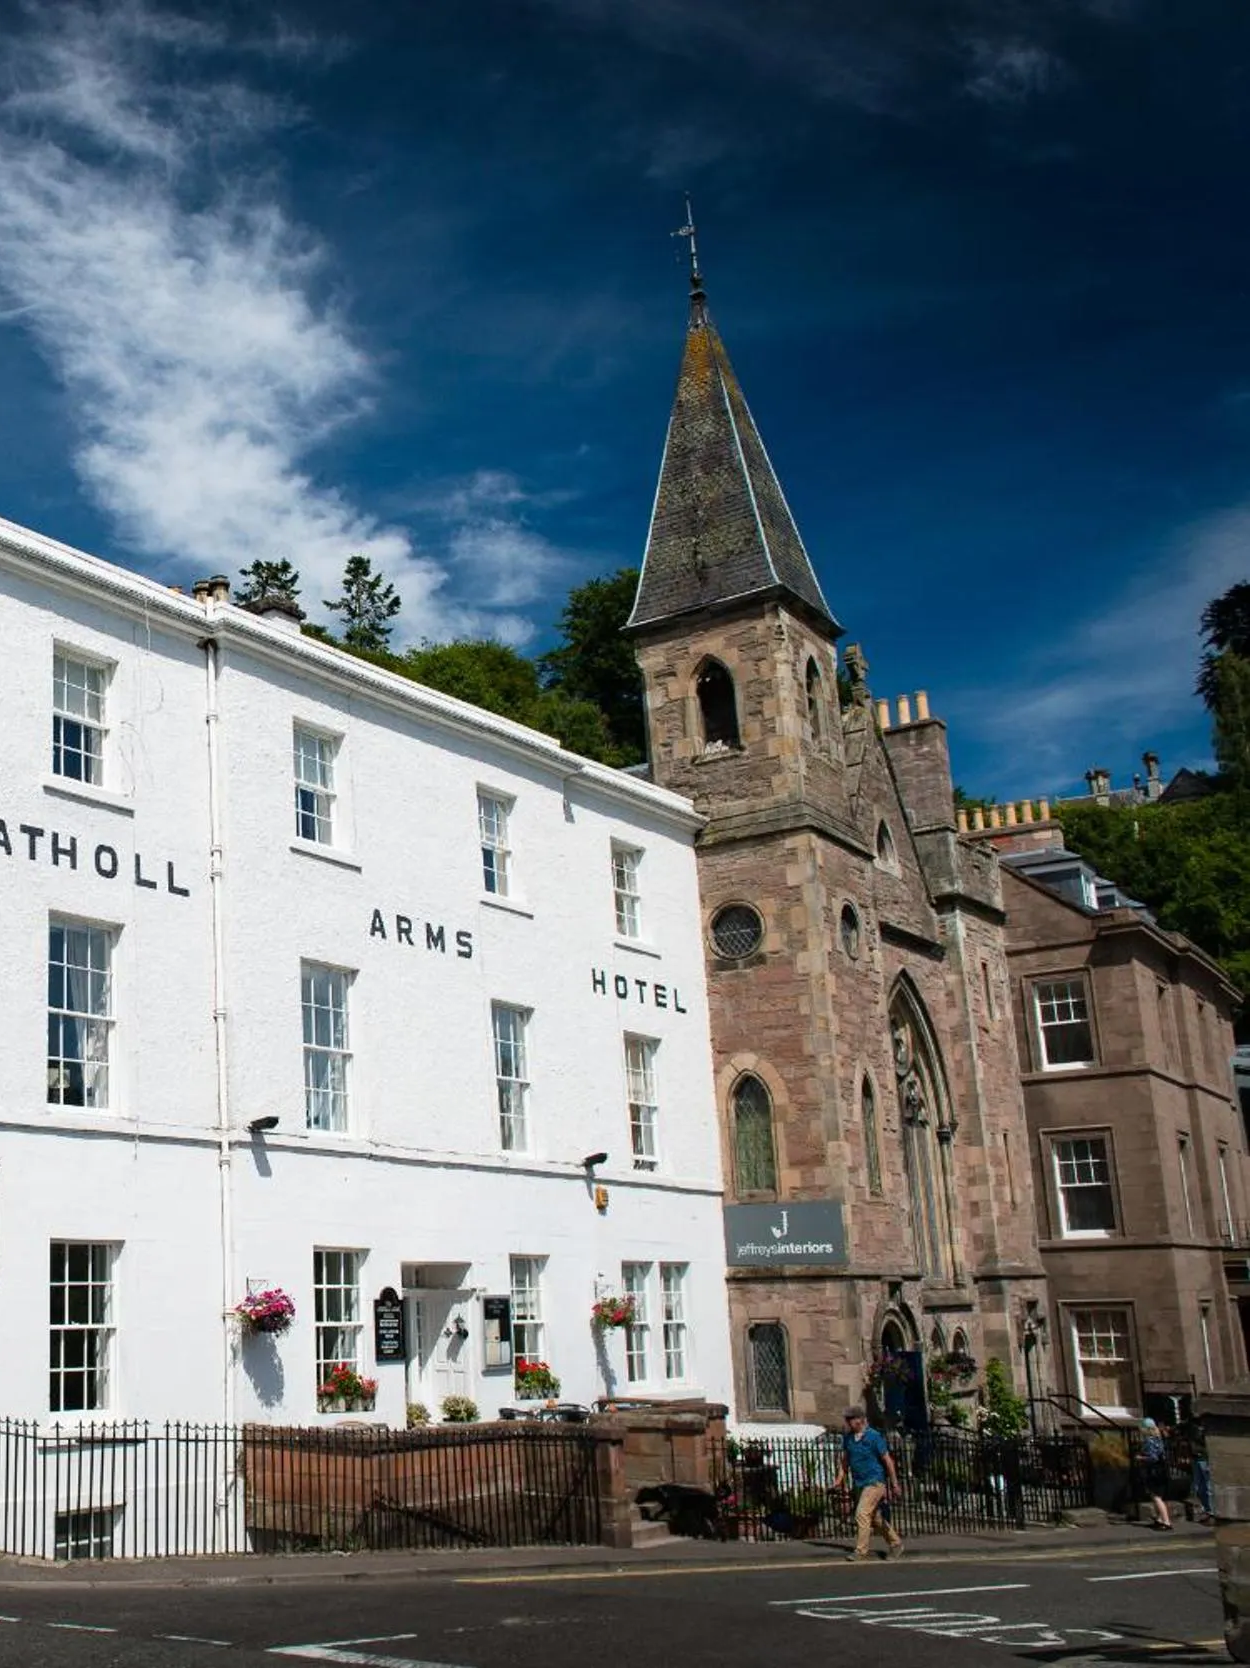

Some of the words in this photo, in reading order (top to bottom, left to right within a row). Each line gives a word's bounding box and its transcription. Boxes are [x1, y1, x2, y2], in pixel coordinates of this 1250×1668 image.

[370, 908, 473, 959] ARMS
[591, 968, 687, 1014] HOTEL
[795, 1607, 1124, 1647] STOP
